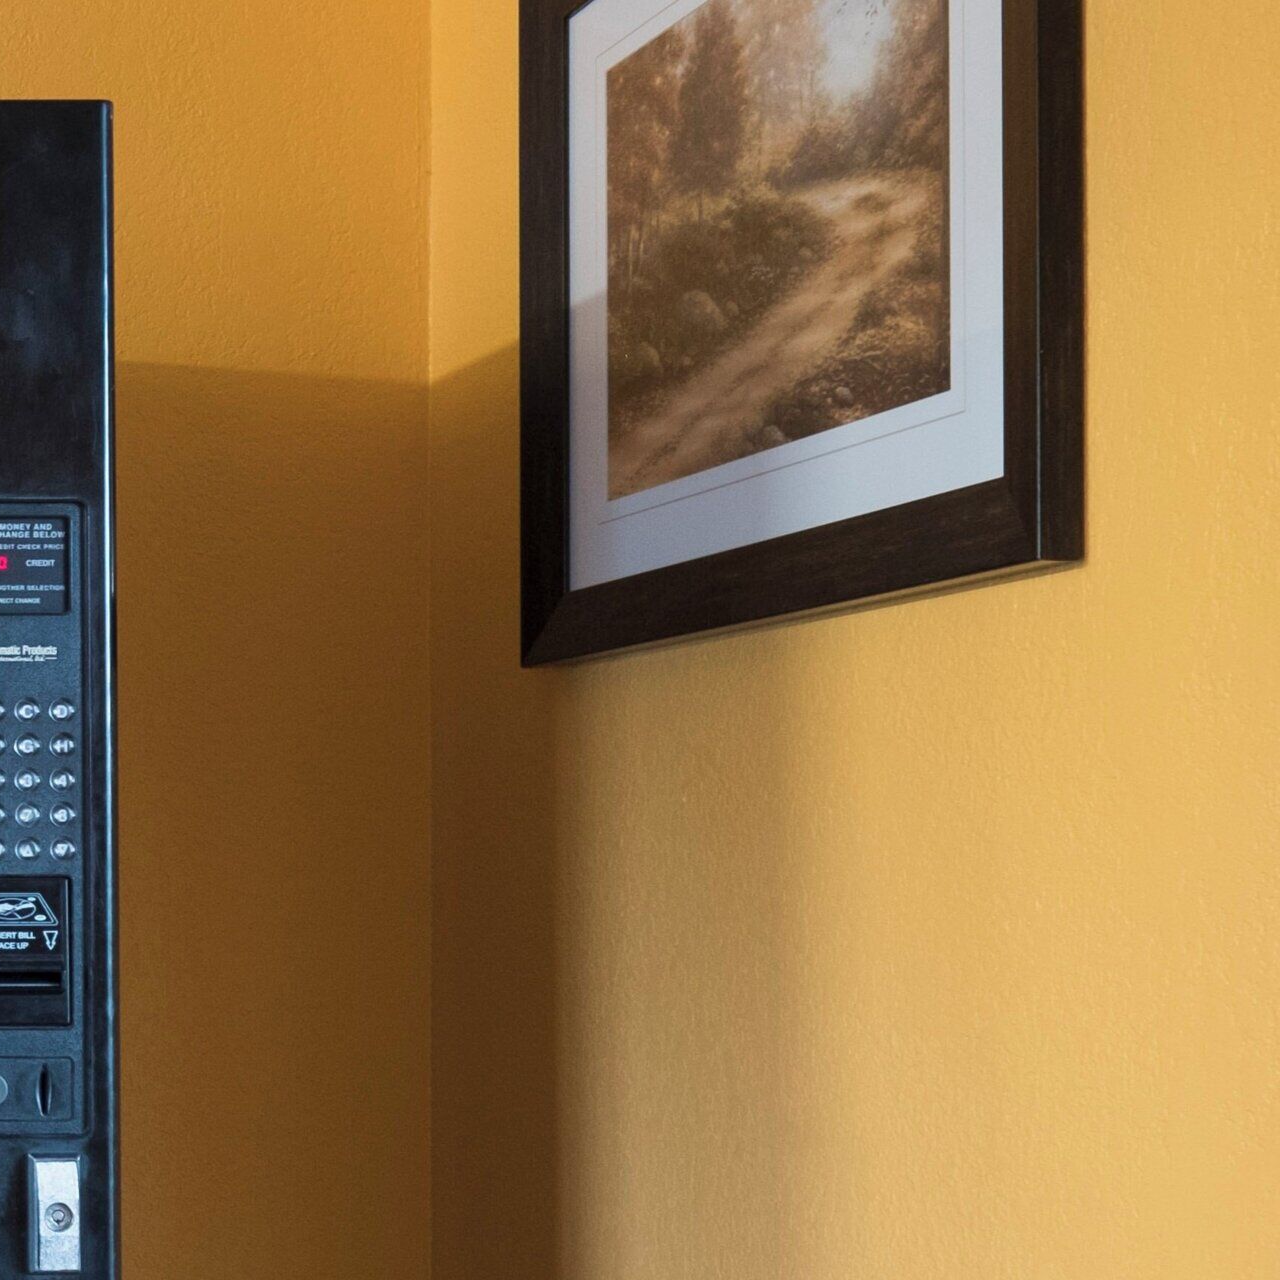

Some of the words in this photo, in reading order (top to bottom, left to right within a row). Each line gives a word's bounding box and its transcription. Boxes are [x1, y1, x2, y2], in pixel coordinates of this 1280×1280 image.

[0, 523, 31, 531] MONEY
[33, 523, 53, 531] AND
[33, 531, 65, 539] BELOW
[25, 559, 56, 567] CREDIT
[22, 645, 57, 655] Products
[18, 931, 36, 939] BILL
[17, 942, 29, 950] UP
